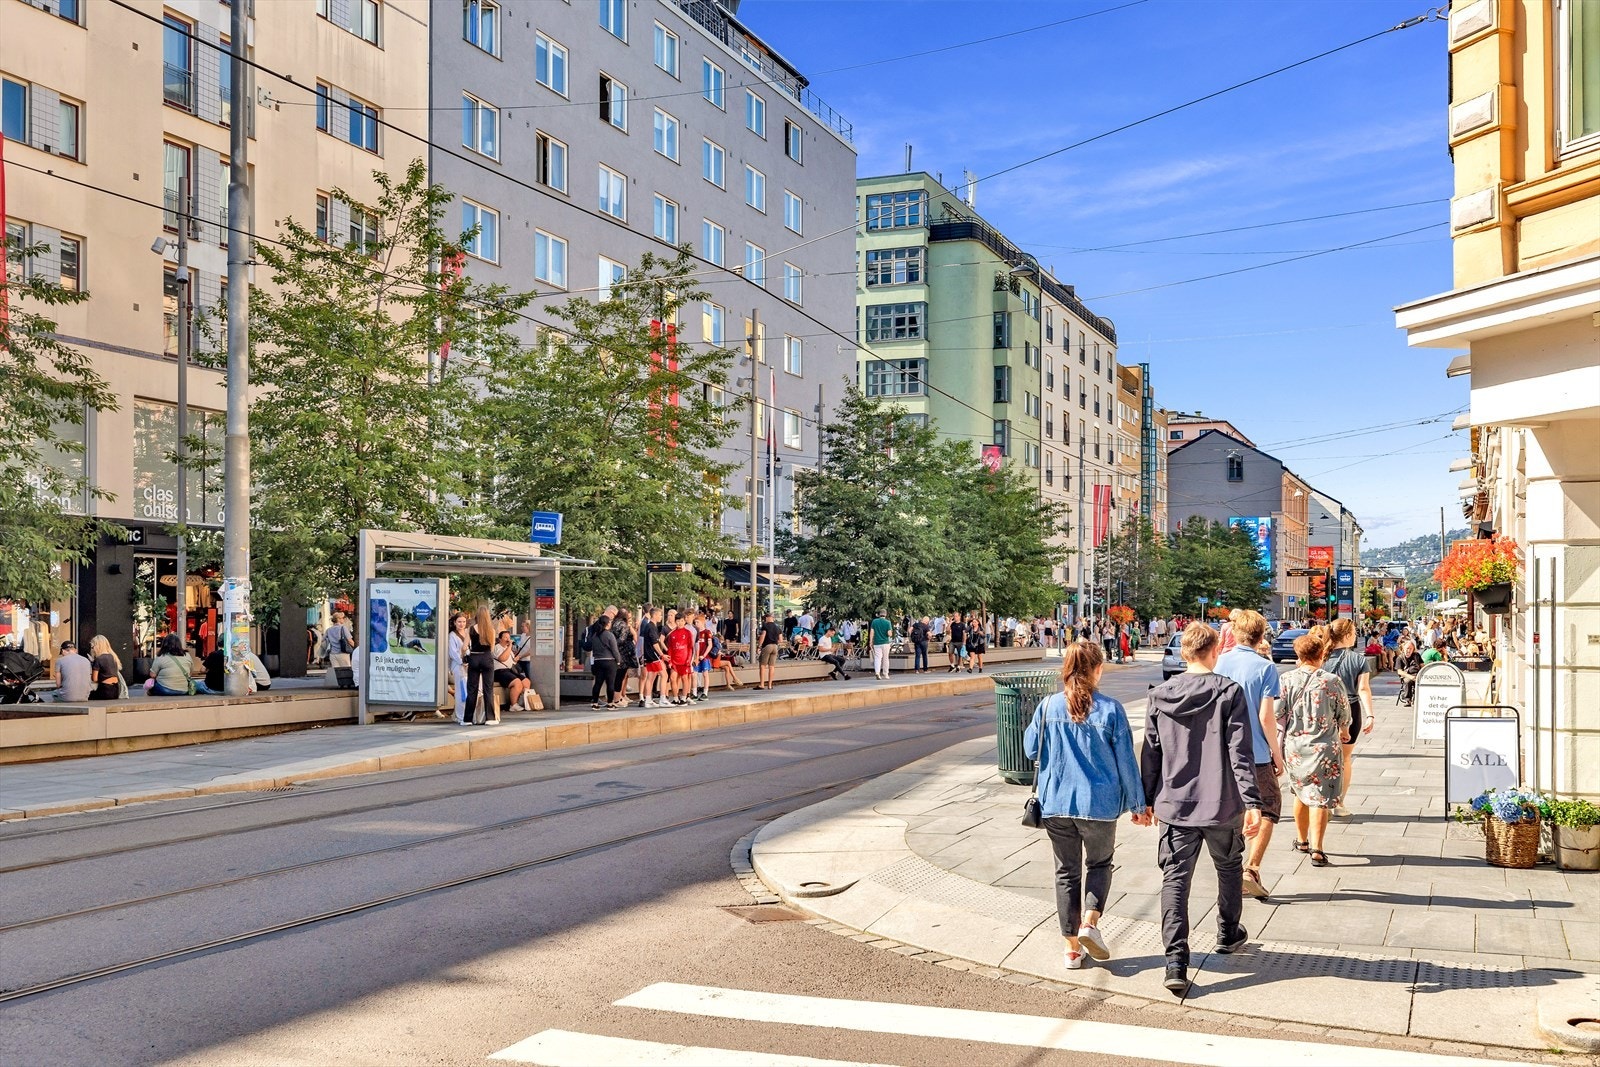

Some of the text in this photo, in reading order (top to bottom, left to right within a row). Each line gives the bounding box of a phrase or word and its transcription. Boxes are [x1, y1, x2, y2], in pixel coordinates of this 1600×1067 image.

[143, 484, 174, 502] clas
[1426, 593, 1432, 601] P
[1460, 753, 1508, 766] SALE
